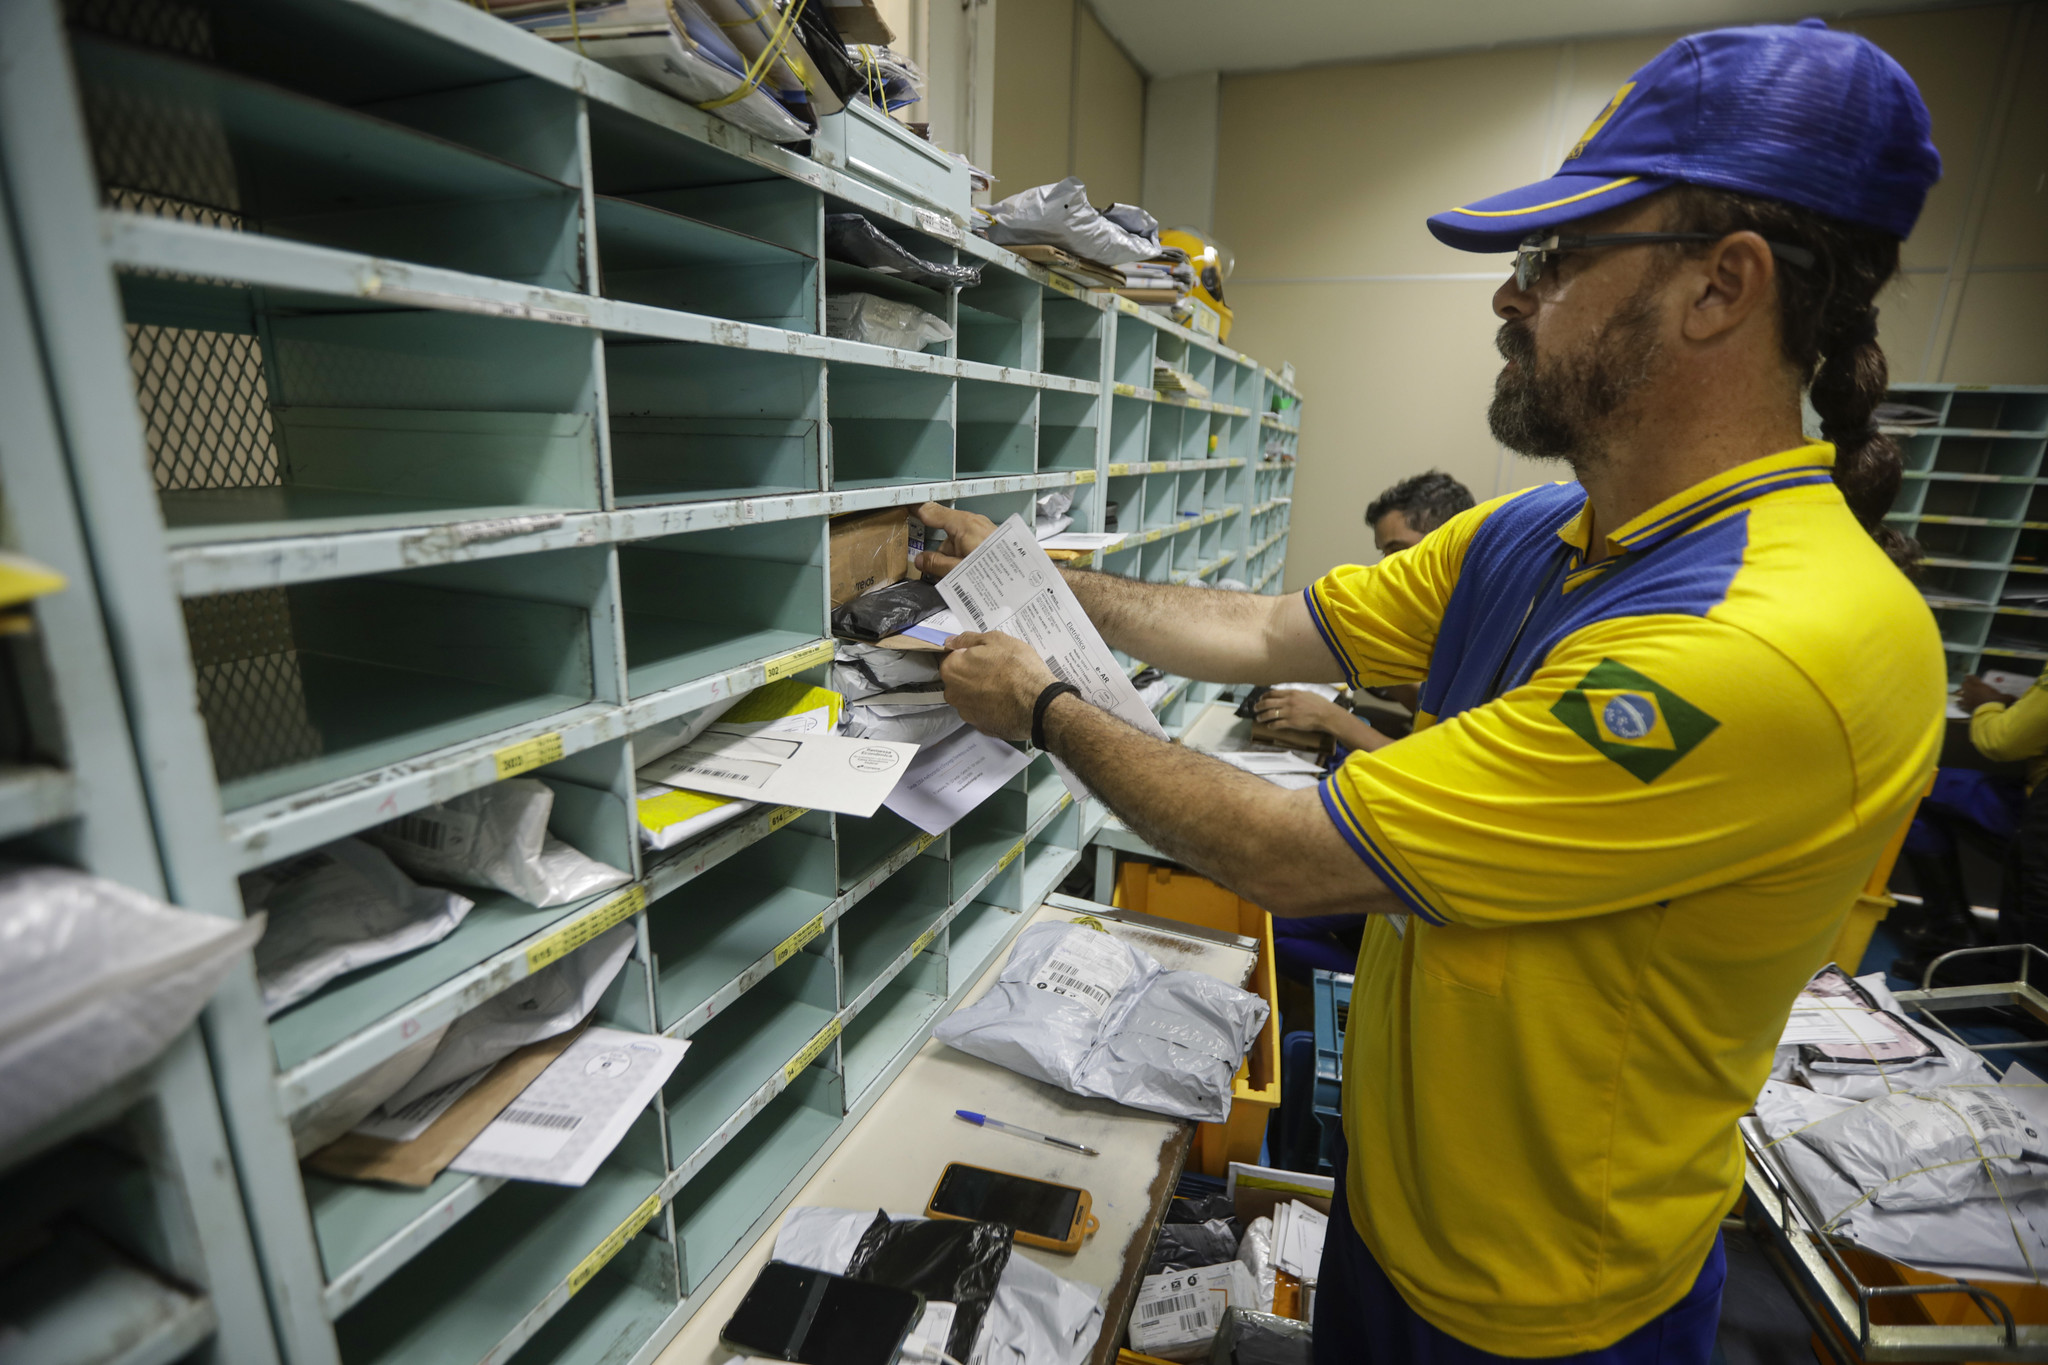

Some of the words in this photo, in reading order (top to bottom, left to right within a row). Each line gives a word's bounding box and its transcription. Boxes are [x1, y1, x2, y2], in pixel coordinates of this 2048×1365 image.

[1066, 621, 1086, 650] Eletrônico
[767, 666, 780, 678] 302
[1100, 673, 1110, 684] AR
[771, 813, 784, 826] 614
